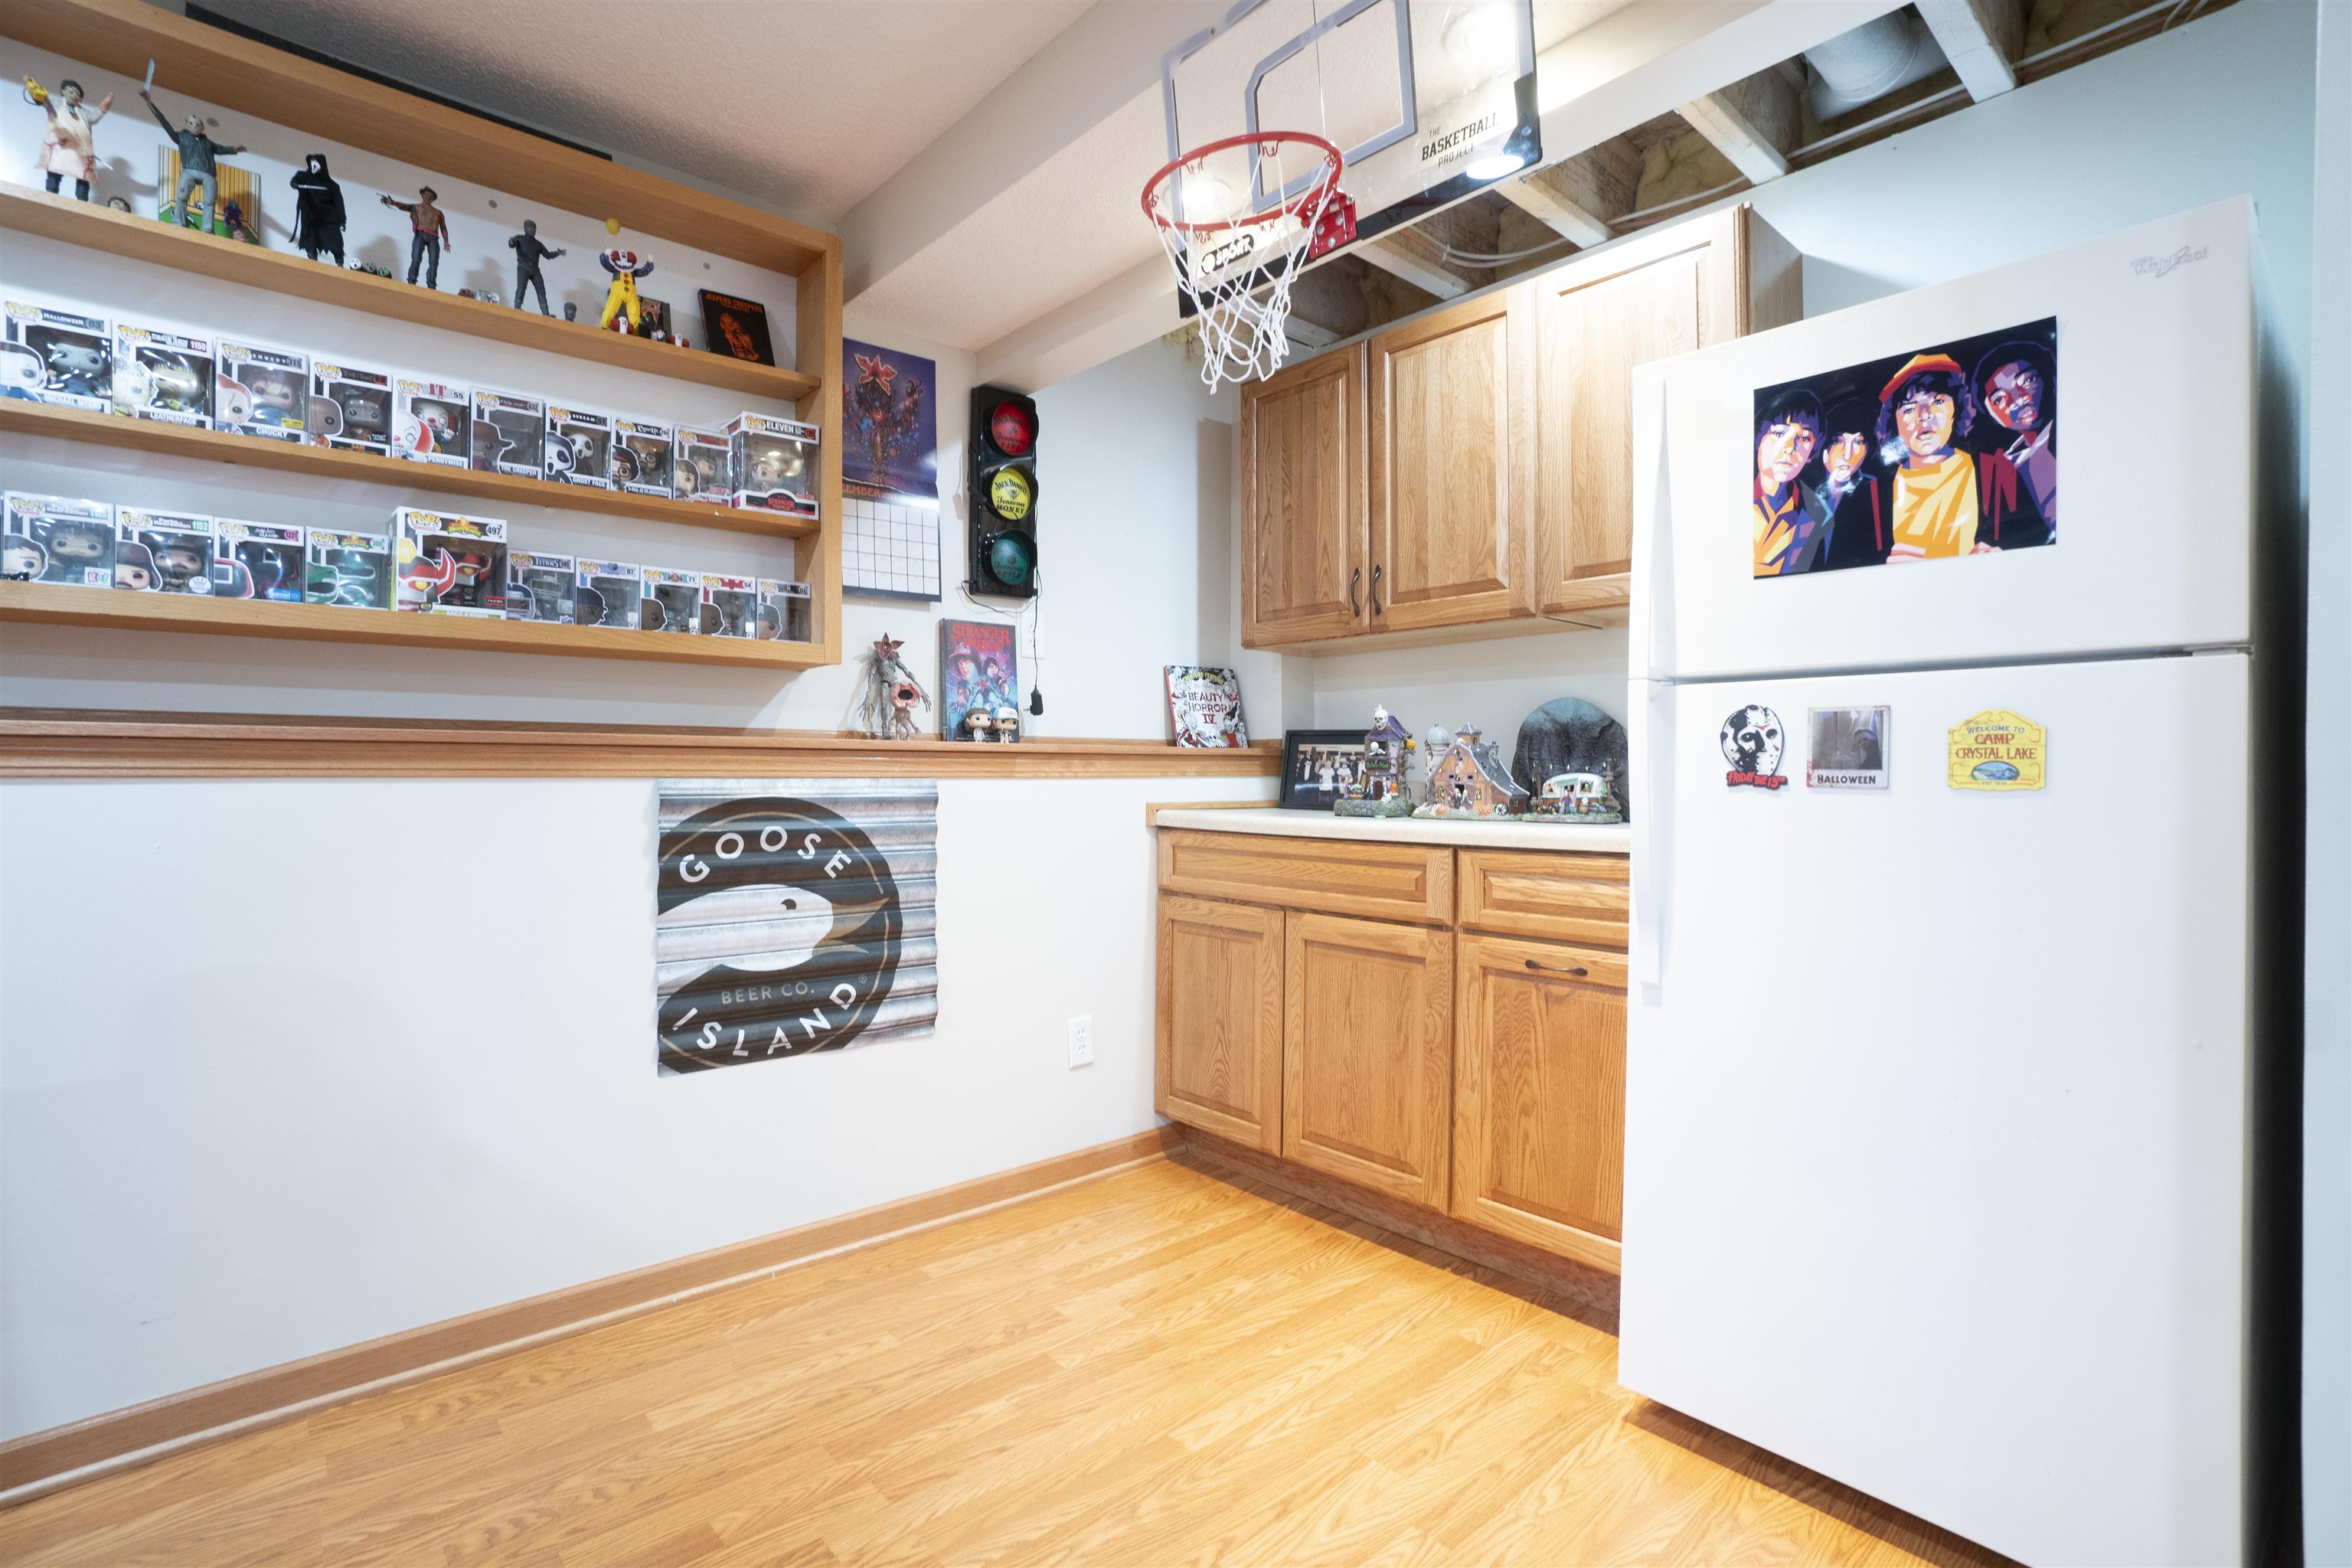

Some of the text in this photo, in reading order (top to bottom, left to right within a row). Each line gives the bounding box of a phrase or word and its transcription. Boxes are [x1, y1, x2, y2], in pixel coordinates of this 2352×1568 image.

[1422, 112, 1498, 162] BASKETBALL
[1429, 126, 1441, 139] THE
[44, 312, 84, 325] HALLOWEEN
[190, 341, 207, 351] 1150
[252, 353, 286, 364] CHUCKY
[150, 410, 197, 426] LEATHERFACE
[256, 427, 289, 438] CHUCKY
[766, 420, 795, 433] ELEVEN
[995, 480, 1009, 491] JACK
[768, 498, 795, 508] STRANGER
[997, 495, 1025, 507] Tennessee
[191, 521, 208, 532] 1152
[487, 526, 501, 536] 497
[952, 622, 1011, 645] STRANGER
[962, 637, 1002, 652] THINGS
[1204, 672, 1225, 686] FEATURE
[1188, 691, 1224, 702] BEAUTY
[1188, 702, 1228, 713] HORROR
[1967, 724, 2011, 734] WELCOME
[1975, 733, 2015, 745] CAMP
[1955, 747, 2038, 760] CRYSTAL LAKE
[1728, 771, 1756, 785] FRIDAY
[1754, 775, 1769, 785] THE
[1818, 775, 1876, 785] HALLOWEEN
[679, 825, 852, 884] GOOSE
[721, 981, 815, 1005] BEER CO.
[671, 982, 858, 1057] ISLAND
